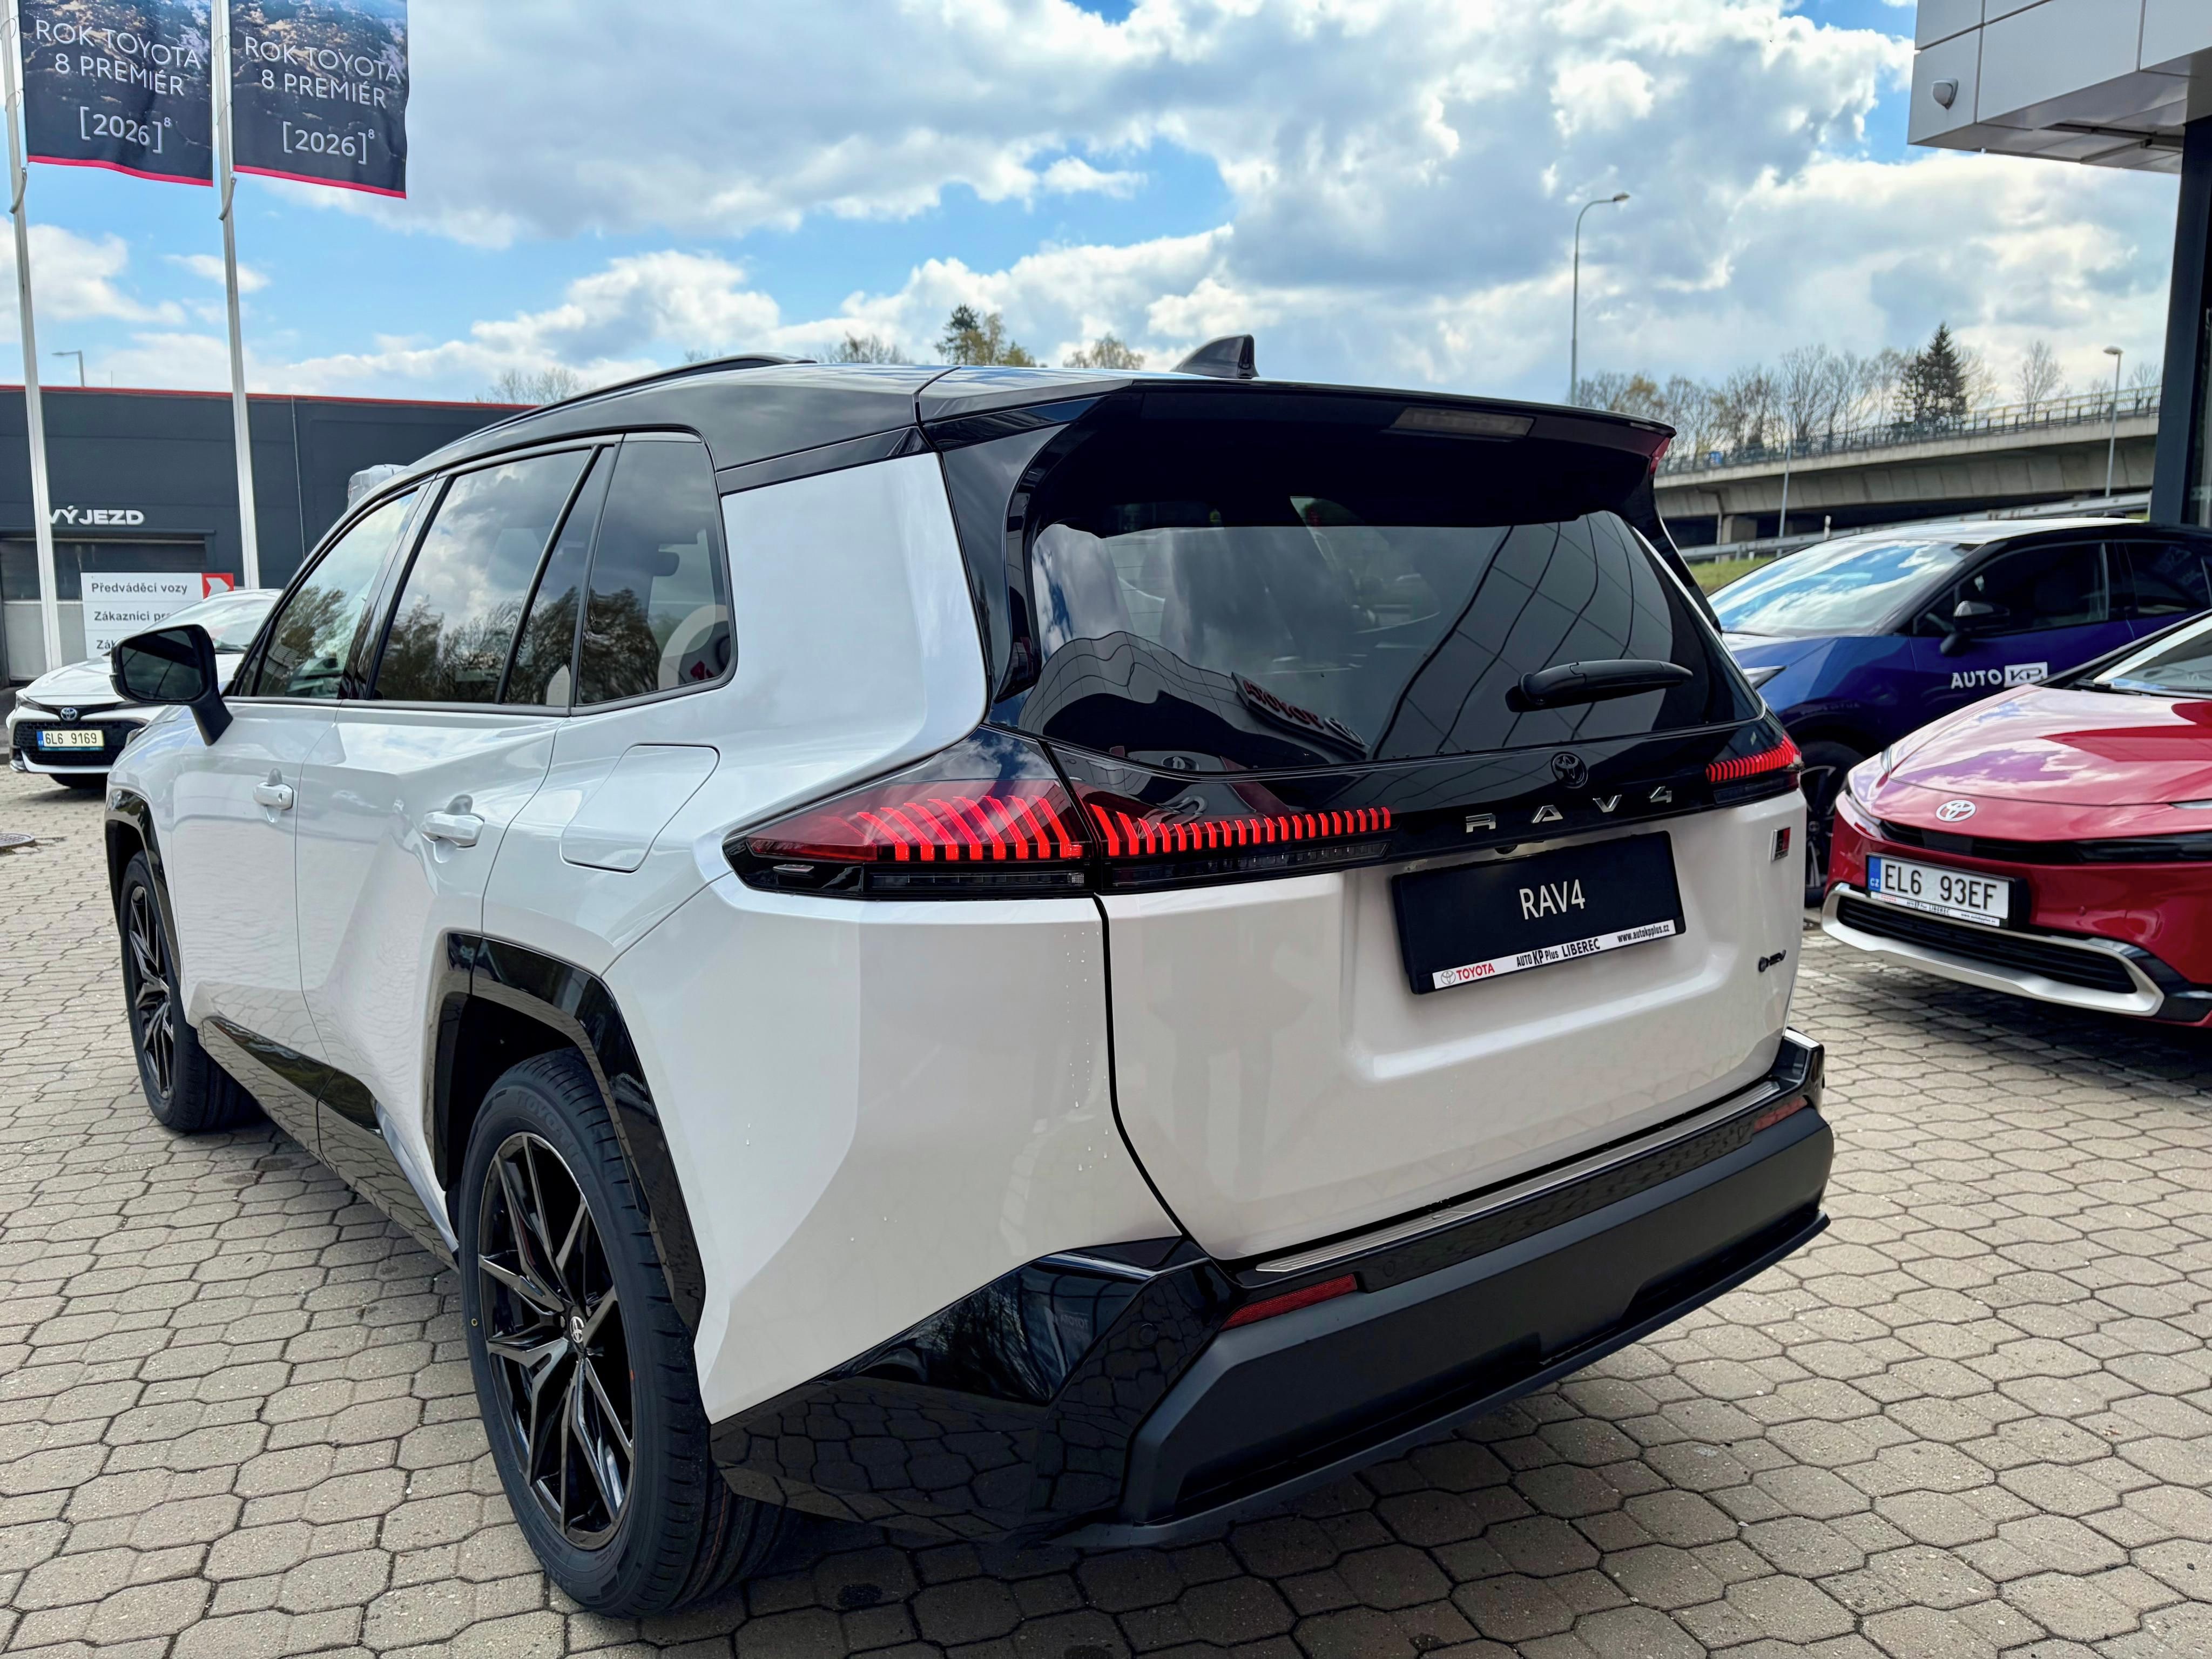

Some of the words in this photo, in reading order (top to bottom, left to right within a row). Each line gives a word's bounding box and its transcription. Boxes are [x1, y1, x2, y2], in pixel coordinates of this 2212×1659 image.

[36, 19, 95, 46] ROK
[102, 28, 201, 70] TOYOTA
[245, 36, 298, 65] ROK
[304, 46, 401, 84] TOYOTA
[55, 53, 70, 74] 8
[80, 56, 185, 96] PREMIÉR
[261, 69, 274, 89] 8
[285, 73, 387, 109] PREMIÉR
[49, 505, 145, 525] VÝJEZD
[91, 582, 157, 593] Předváděcí
[160, 584, 187, 595] vozy
[1951, 669, 2002, 689] AUTO
[45, 733, 63, 744] 6L6
[71, 733, 97, 744] 9169
[1465, 786, 1673, 833] RAV4
[1519, 879, 1586, 920] RAV4
[1870, 878, 1879, 888] CZ
[1885, 864, 1922, 895] EL6
[1940, 876, 1997, 910] 93EF
[1455, 963, 1495, 981] TOYOTA
[1516, 954, 1533, 967] AUTO
[1532, 949, 1543, 965] KP
[1545, 949, 1559, 961] Plus
[1561, 938, 1600, 957] LIBEREC
[1617, 924, 1670, 942] www.autokpplus.cz
